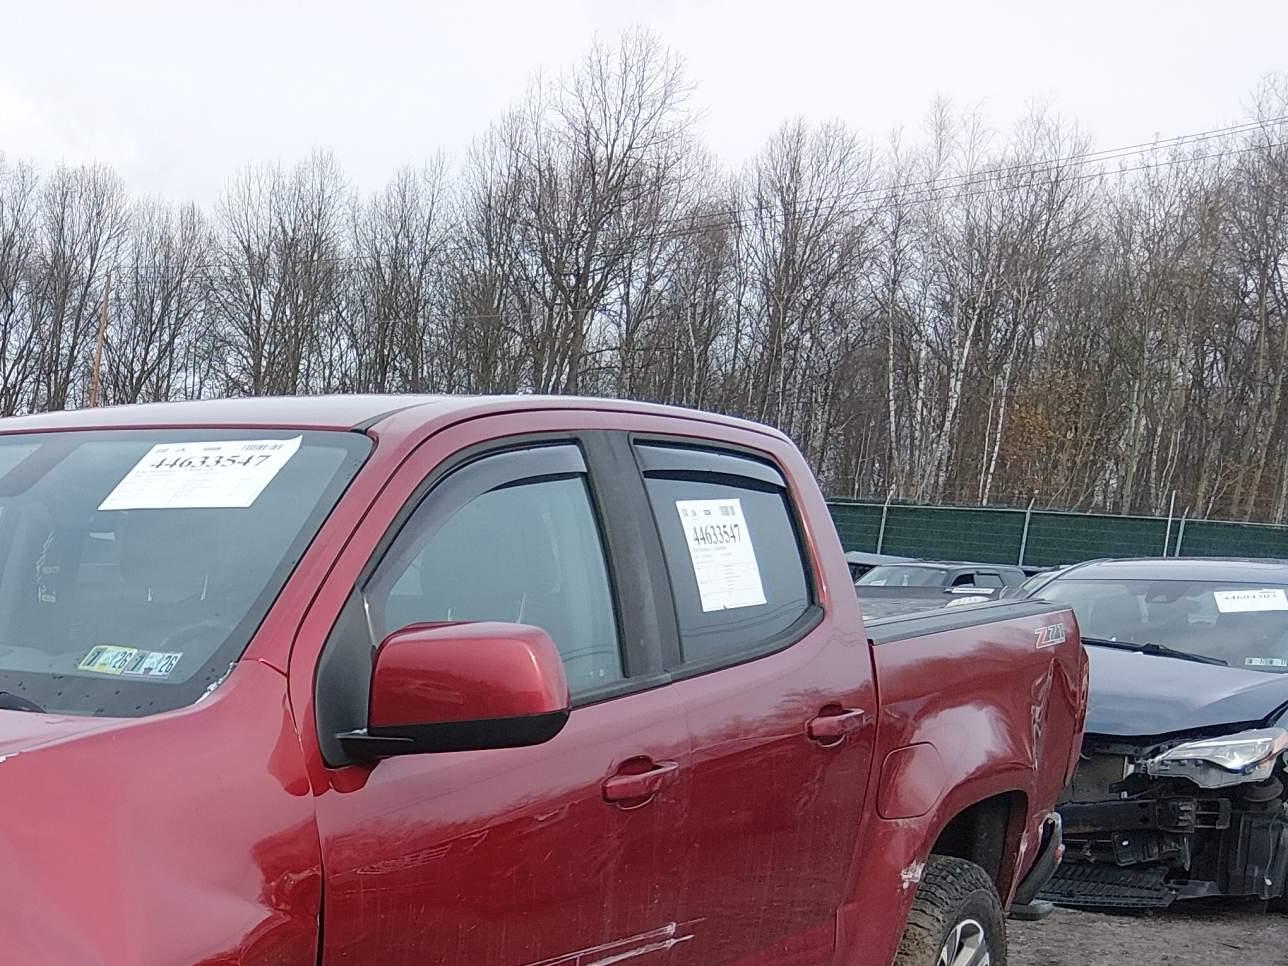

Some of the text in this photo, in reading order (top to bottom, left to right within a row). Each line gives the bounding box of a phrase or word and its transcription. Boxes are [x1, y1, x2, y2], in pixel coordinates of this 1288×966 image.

[150, 453, 272, 469] 44633547
[693, 523, 742, 545] 44633547
[1034, 623, 1066, 649] Z71
[158, 655, 179, 673] 26
